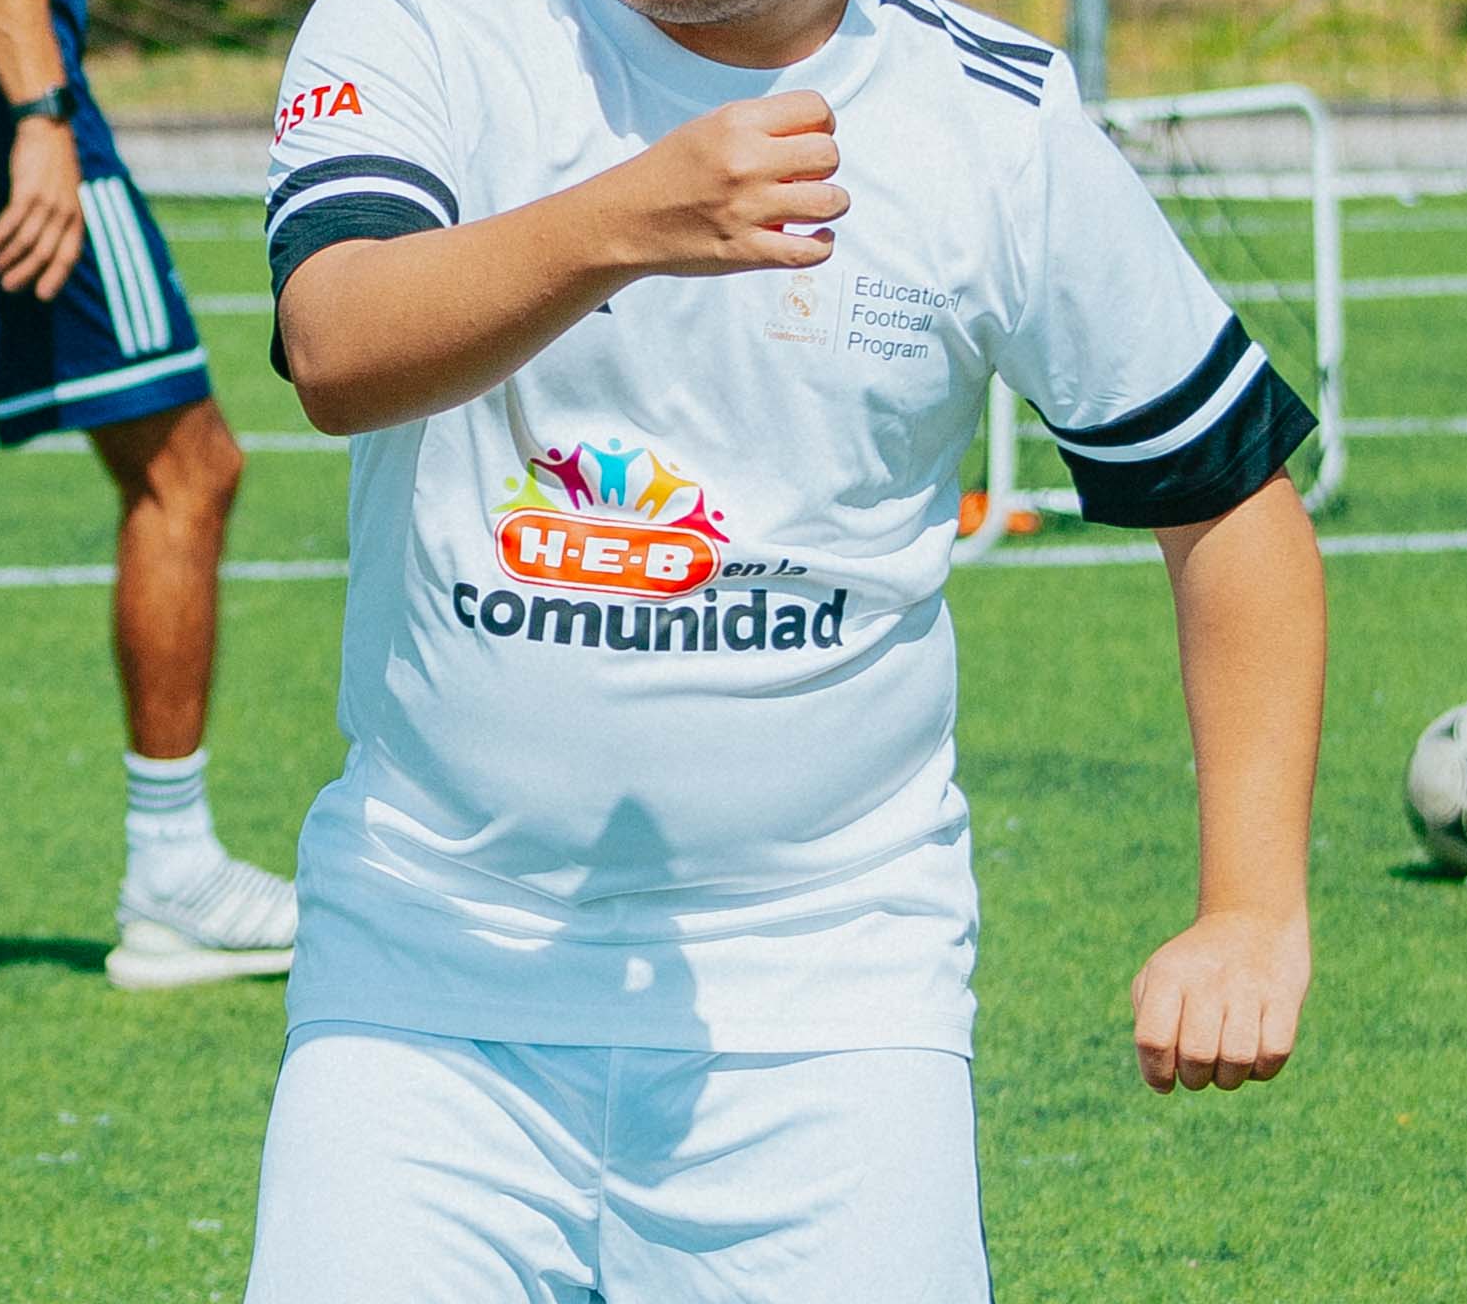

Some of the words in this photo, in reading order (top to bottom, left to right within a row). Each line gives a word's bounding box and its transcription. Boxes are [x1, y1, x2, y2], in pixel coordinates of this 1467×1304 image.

[851, 303, 934, 332] Football
[848, 331, 929, 361] Program
[519, 525, 695, 582] H-E-B
[722, 562, 766, 578] en
[452, 581, 848, 652] comunidad
